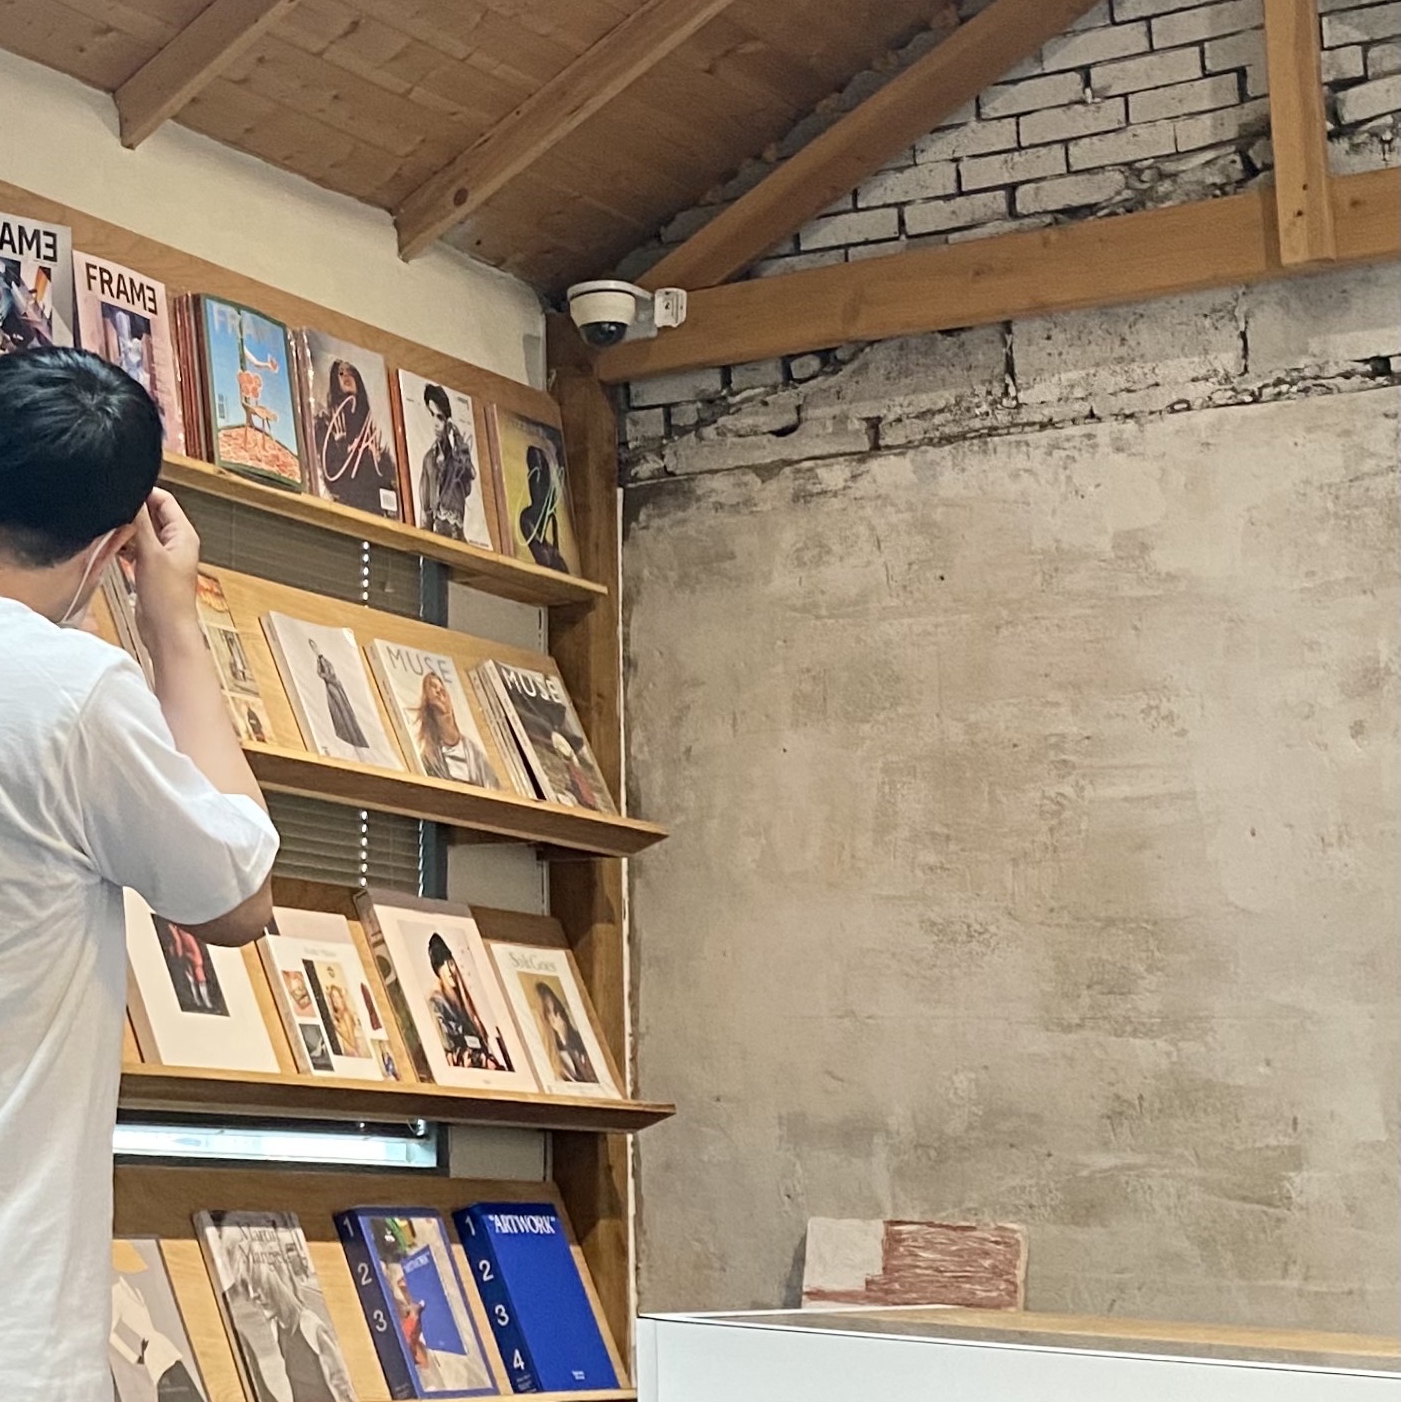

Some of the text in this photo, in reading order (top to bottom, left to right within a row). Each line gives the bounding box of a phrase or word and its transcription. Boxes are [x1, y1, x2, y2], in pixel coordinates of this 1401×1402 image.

[386, 646, 453, 684] MUSE
[502, 666, 562, 703] MUSE
[343, 1218, 387, 1332] 1 2 3
[465, 1215, 524, 1370] 1 2 3 4
